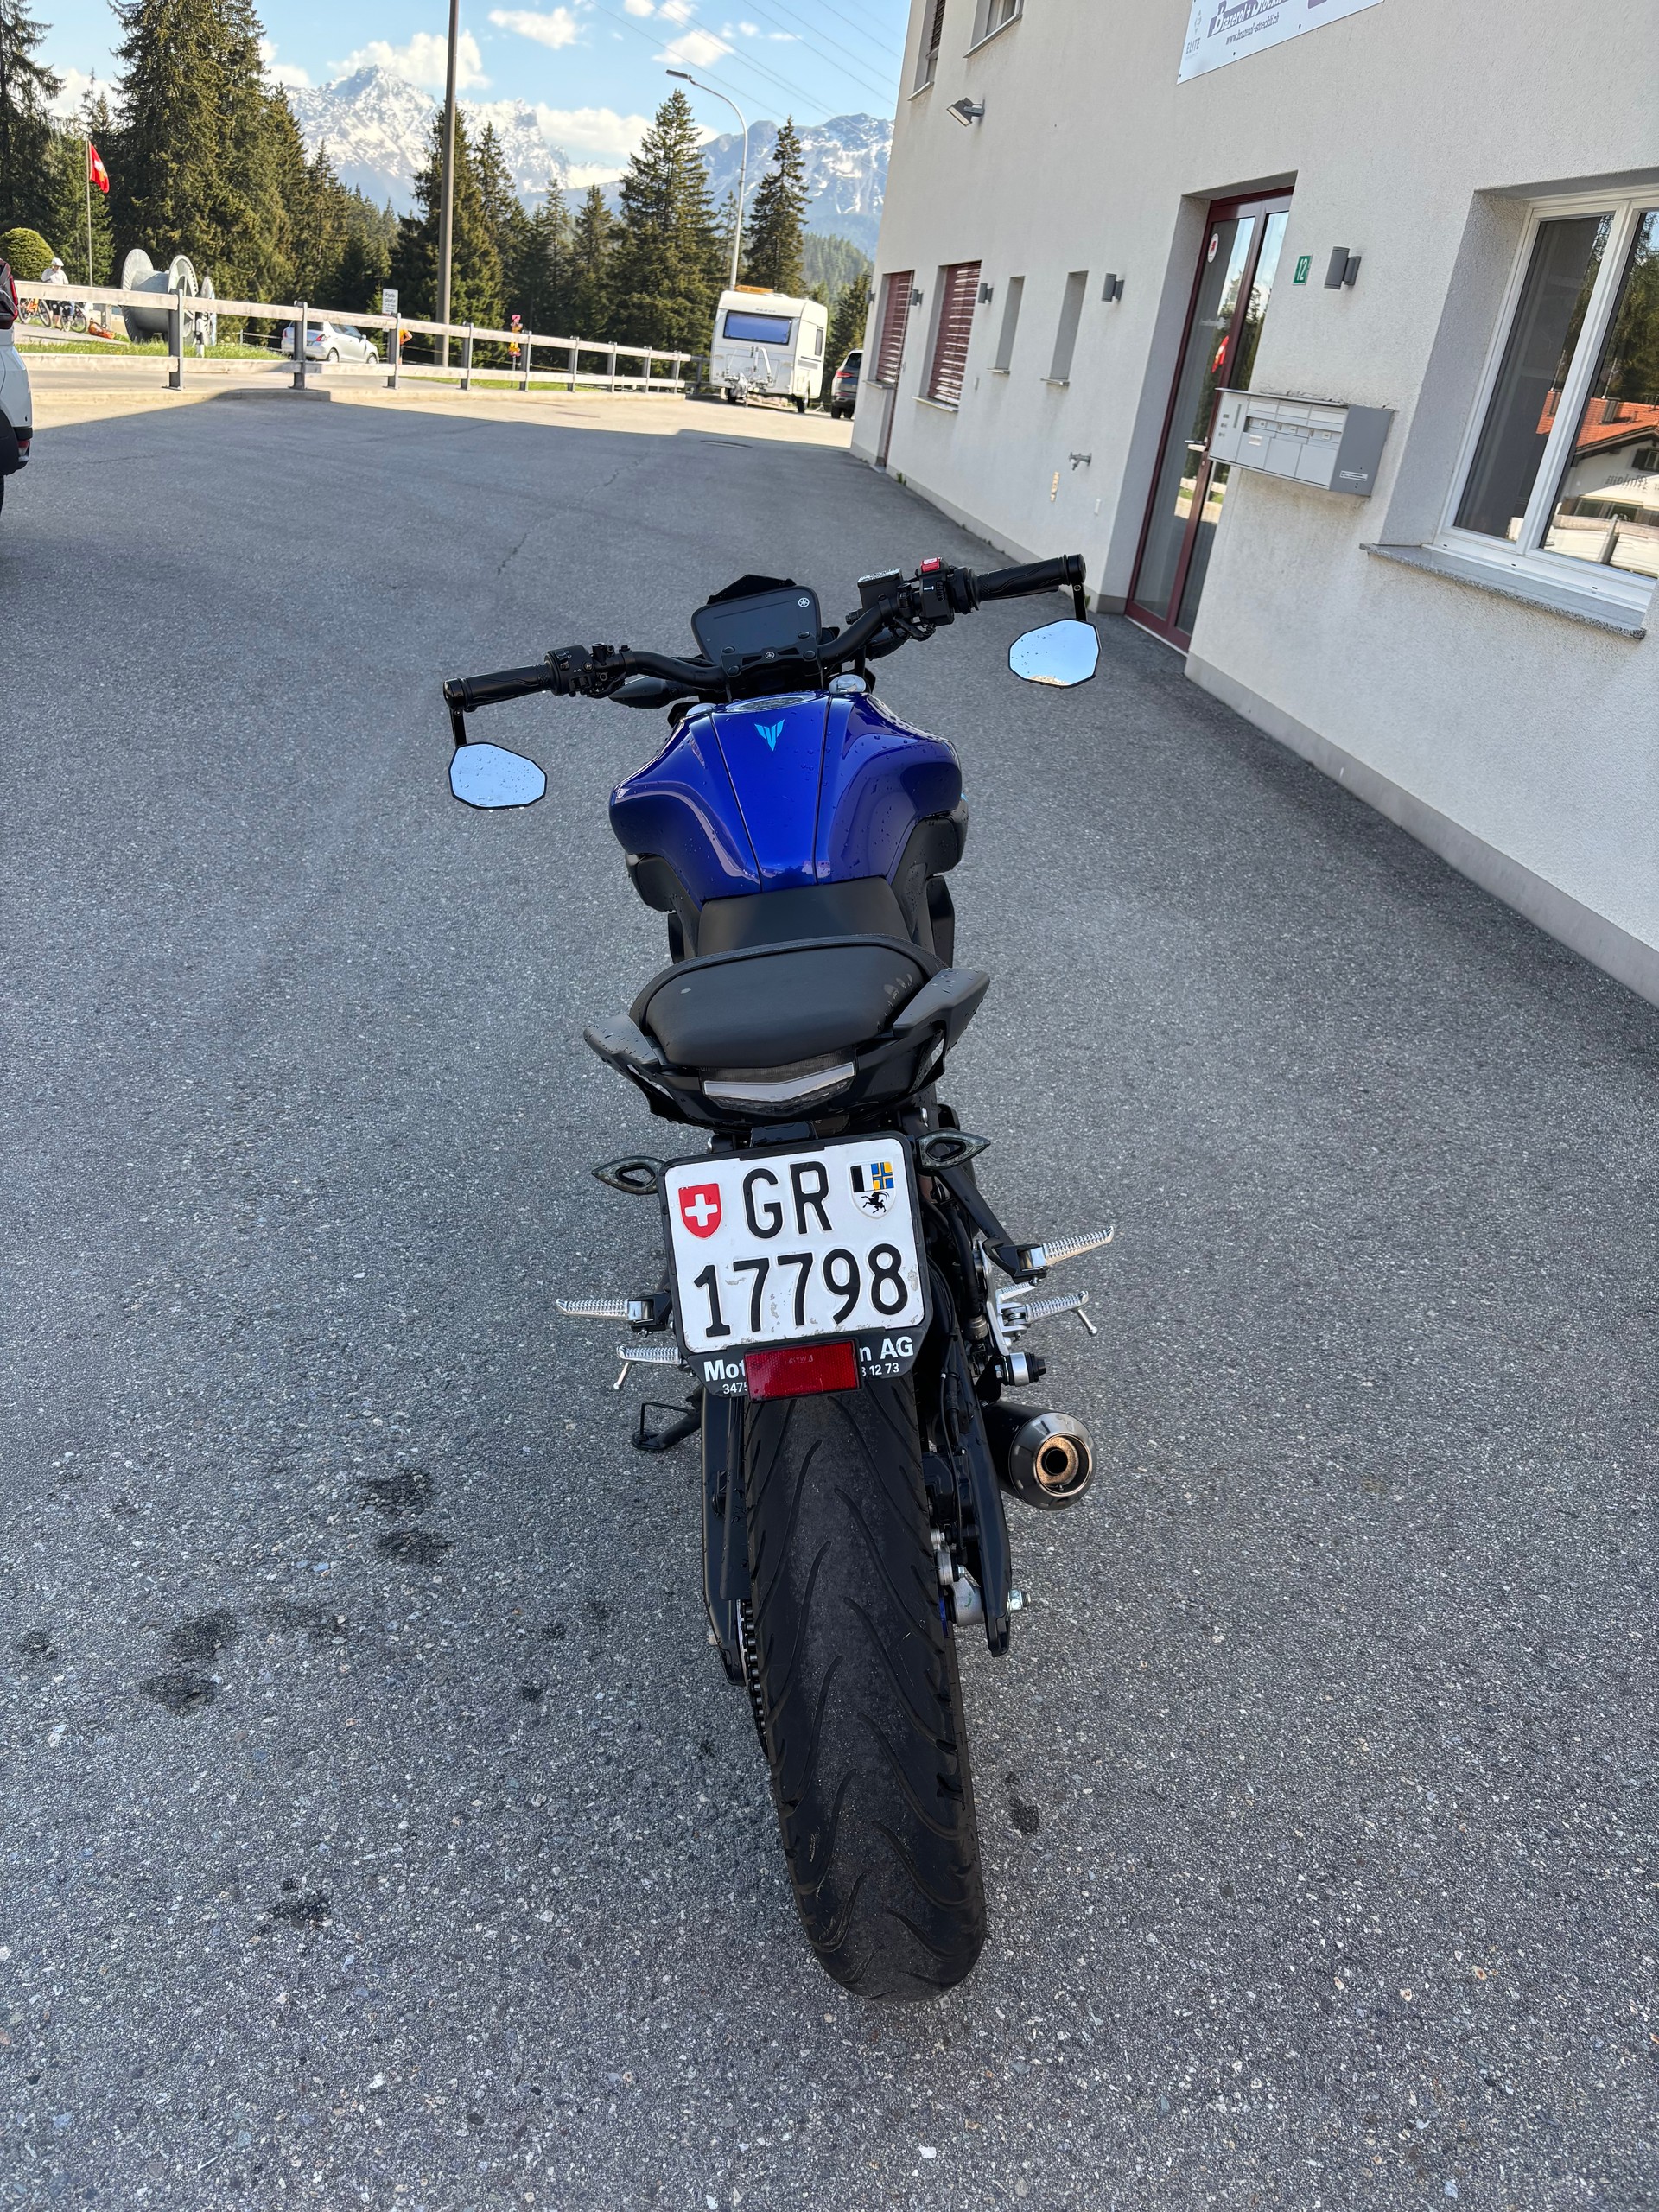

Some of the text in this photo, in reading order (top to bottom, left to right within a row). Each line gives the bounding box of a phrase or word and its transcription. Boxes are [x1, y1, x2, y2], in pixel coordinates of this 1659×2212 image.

[1296, 257, 1308, 281] 12
[742, 1160, 833, 1239] GR
[693, 1243, 909, 1338] 17798
[703, 1358, 746, 1382] Mot
[880, 1336, 914, 1360] AG
[869, 1364, 882, 1376] 12
[885, 1363, 899, 1374] 73
